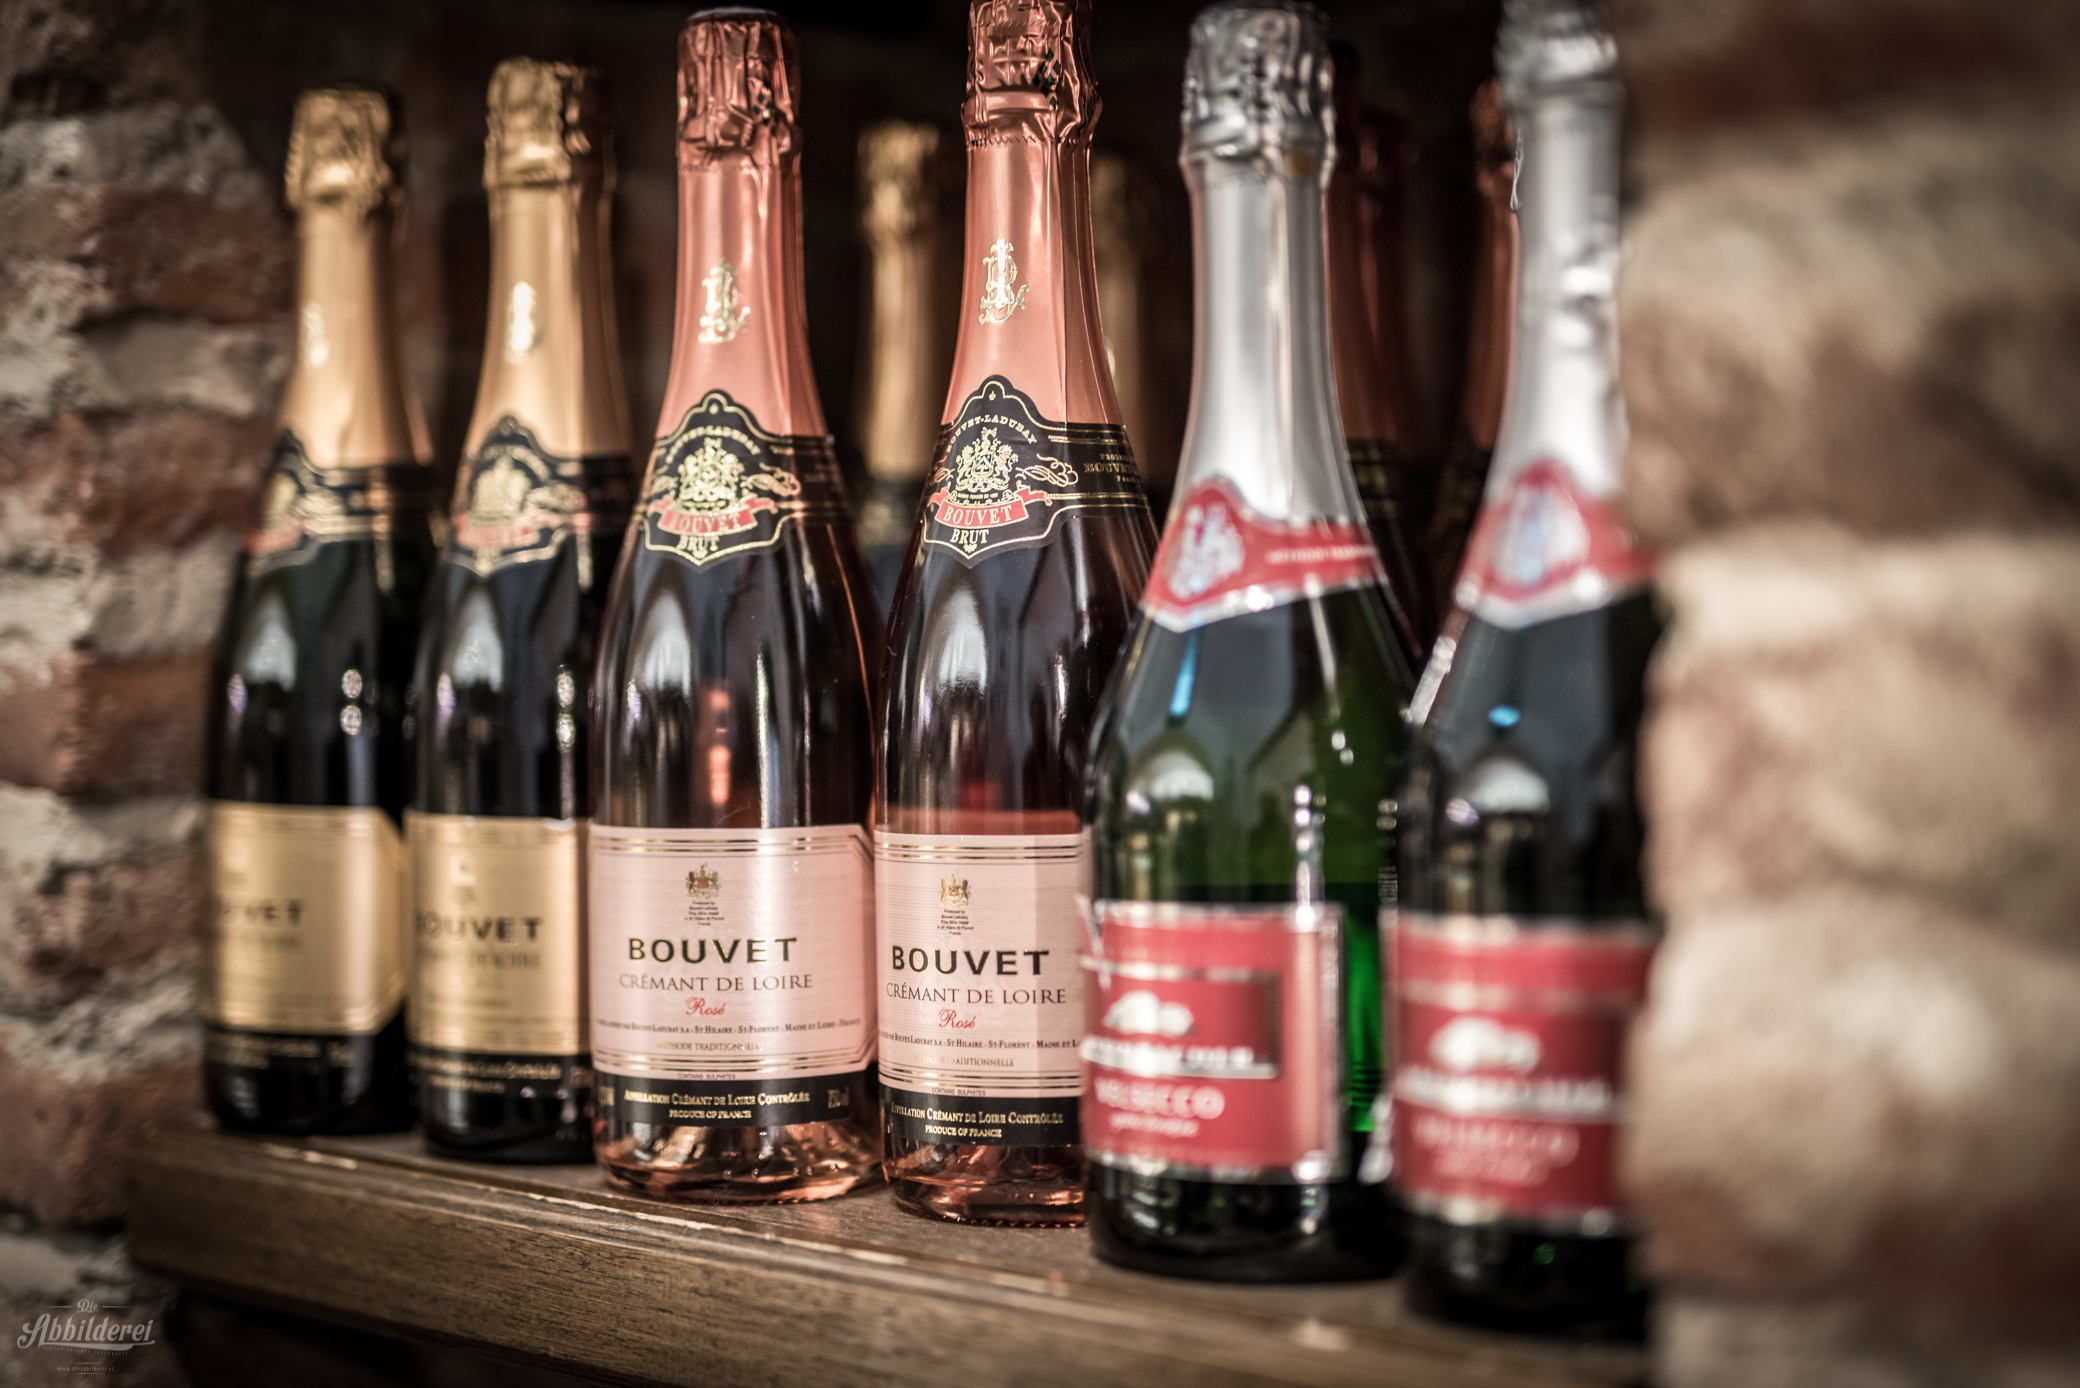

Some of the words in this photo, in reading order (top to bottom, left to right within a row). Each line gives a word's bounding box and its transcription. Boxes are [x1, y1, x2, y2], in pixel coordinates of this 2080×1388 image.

[943, 505, 1013, 526] BOUVET
[677, 535, 720, 551] BRUT
[949, 528, 990, 545] BRUT
[628, 937, 798, 965] BOUVET
[892, 945, 1050, 976] BOUVET
[619, 972, 709, 991] CRÉMANT
[716, 976, 744, 992] DE
[753, 974, 813, 991] LOIRE
[886, 982, 960, 1003] CRÉMANT
[967, 988, 994, 1004] DE
[1002, 988, 1067, 1005] LOIRE
[684, 997, 727, 1016] Rosé
[938, 1008, 976, 1029] Rosé
[671, 1092, 713, 1105] CRÉMANT
[713, 1096, 726, 1105] DE
[727, 1094, 756, 1106] LOIRE
[931, 1087, 956, 1095] CONTAINS
[957, 1089, 986, 1097] SULPHITES
[669, 1109, 706, 1119] PRODUCE
[705, 1110, 718, 1119] OF
[717, 1109, 752, 1119] FRANCE
[926, 1107, 964, 1122] CRÉMANT
[964, 1112, 977, 1123] DE
[978, 1111, 1006, 1124] LOIRE
[925, 1124, 957, 1136] PRODUCE
[957, 1127, 968, 1137] OF
[968, 1127, 1003, 1138] FRANCE
